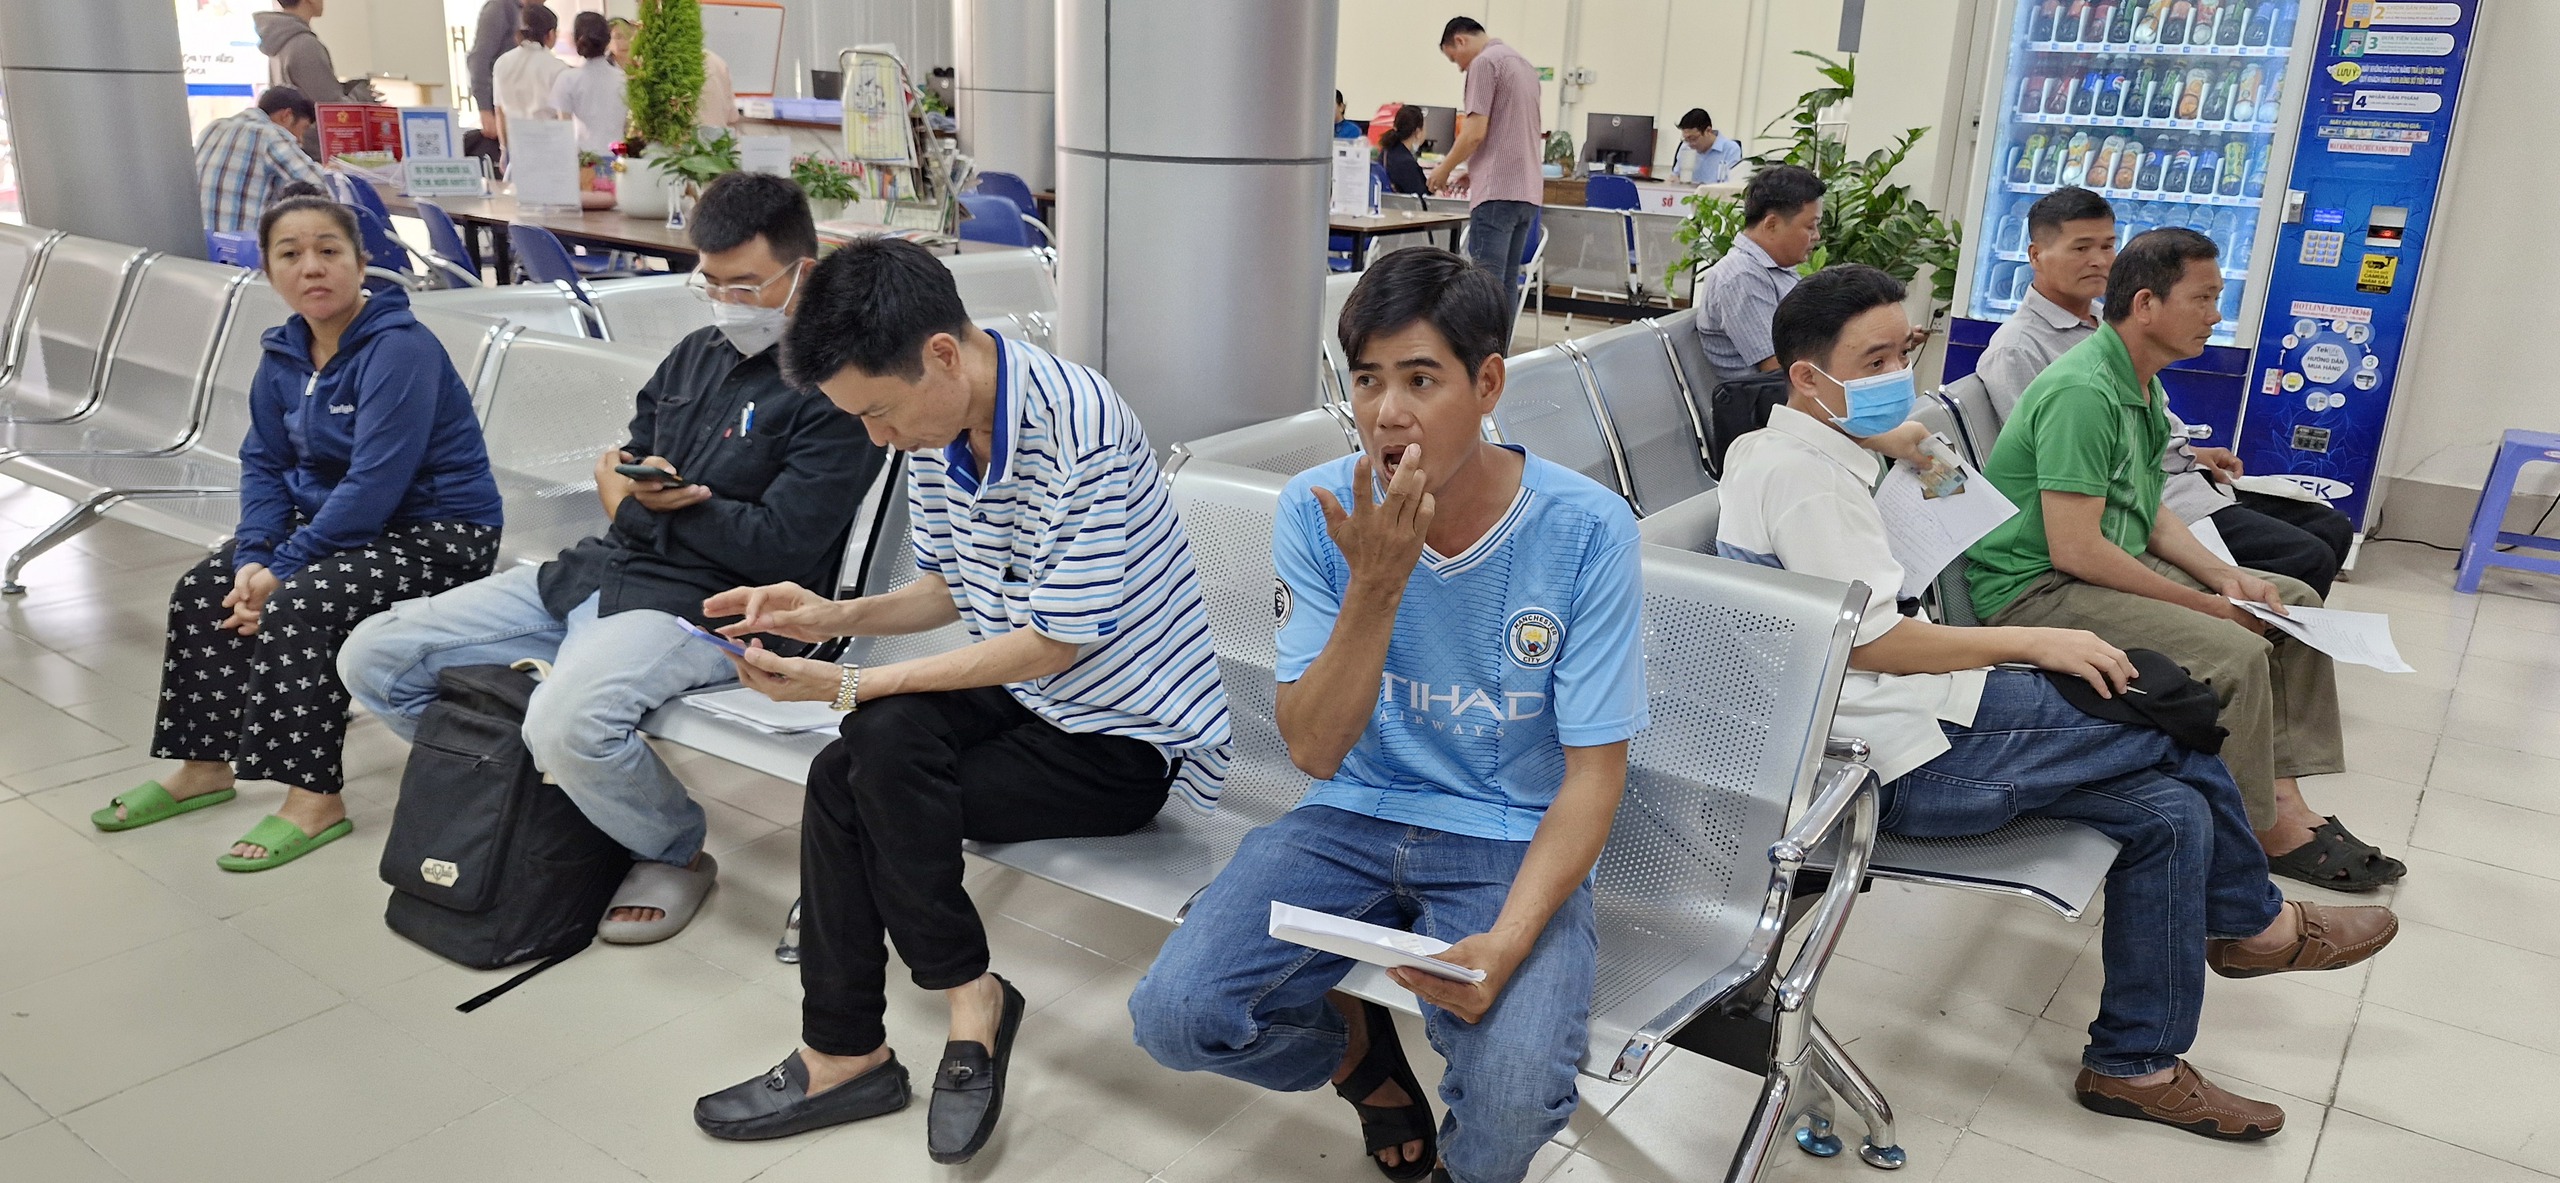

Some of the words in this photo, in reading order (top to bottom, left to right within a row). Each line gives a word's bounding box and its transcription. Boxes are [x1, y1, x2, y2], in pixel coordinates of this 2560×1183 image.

[2374, 6, 2385, 19] 2
[2368, 37, 2378, 49] 3
[2356, 96, 2367, 108] 4
[1662, 194, 1674, 207] SỞ
[2335, 321, 2344, 330] 2
[2287, 336, 2293, 346] 1
[2366, 358, 2374, 367] 3
[1514, 614, 1558, 636] MANCHESTER
[1382, 672, 1546, 721] TIHAD
[1379, 710, 1505, 737] AIRWAYS
